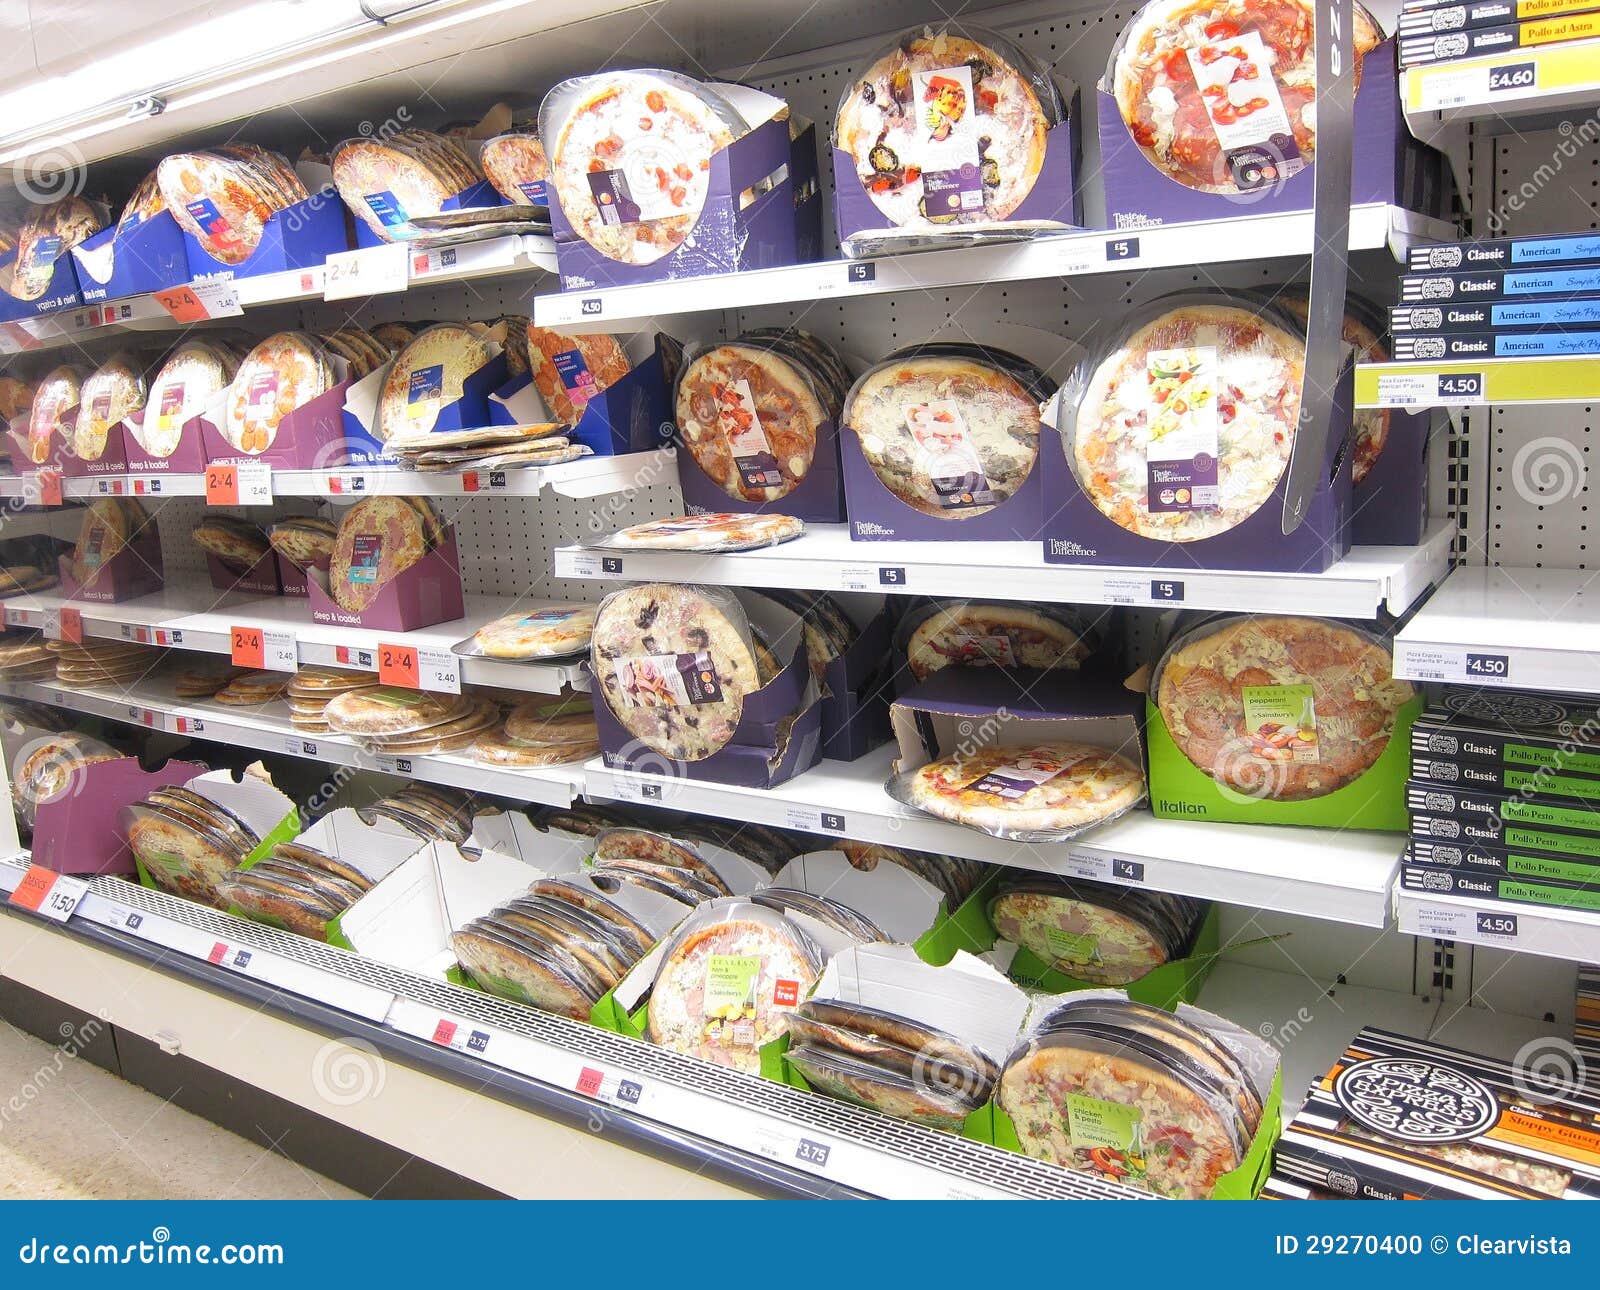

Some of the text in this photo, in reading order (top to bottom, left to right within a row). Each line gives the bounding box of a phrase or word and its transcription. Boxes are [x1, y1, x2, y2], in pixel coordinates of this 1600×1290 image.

[1528, 23, 1593, 38] Pollo ad Astra
[1330, 0, 1342, 77] za
[1490, 70, 1533, 89] £4.60
[1114, 242, 1129, 256] £5
[1468, 248, 1504, 261] Classic
[1519, 246, 1561, 257] American
[855, 266, 867, 278] £5
[1460, 280, 1497, 292] Classic
[1511, 279, 1553, 289] American
[1448, 311, 1484, 322] Classic
[1499, 310, 1541, 320] American
[1451, 341, 1488, 352] Classic
[1502, 340, 1544, 350] American
[1440, 379, 1477, 393] £4.50
[210, 473, 217, 489] 2
[1152, 469, 1172, 479] Taste
[1154, 474, 1191, 483] Difference
[1049, 539, 1072, 550] Taste
[1051, 545, 1096, 557] Difference
[608, 560, 616, 570] £5
[886, 570, 897, 582] £5
[284, 585, 300, 594] deep
[1160, 583, 1174, 597] £5
[314, 610, 361, 624] deep & loaded
[236, 633, 243, 648] 2
[383, 651, 392, 667] 2
[1467, 658, 1504, 673] £4.50
[1249, 696, 1287, 704] pepperoni
[1464, 743, 1556, 763] Classic Pollo Pesto
[1464, 769, 1557, 789] Classic Pollo Pesto
[1159, 799, 1207, 814] Italian
[1461, 801, 1494, 813] Classic
[1508, 808, 1529, 817] Pollo
[1531, 810, 1554, 820] Pesto
[1465, 827, 1499, 839] Classic
[1512, 833, 1533, 843] Pollo
[1535, 836, 1558, 847] Pesto
[1121, 863, 1134, 876] £4
[1467, 854, 1561, 874] Classic Pollo Pesto
[1458, 879, 1551, 899] Classic Pollo Pesto
[1477, 917, 1514, 932] £4.50
[777, 990, 795, 1000] free
[580, 1078, 597, 1090] FREE
[1381, 1077, 1456, 1103] PIZZA
[1352, 1079, 1476, 1121] EXPRESS
[1074, 1107, 1103, 1119] chicken
[1082, 1116, 1102, 1125] pesto
[1509, 1115, 1551, 1134] Sloppy
[1082, 1132, 1121, 1147] Sainsbury's
